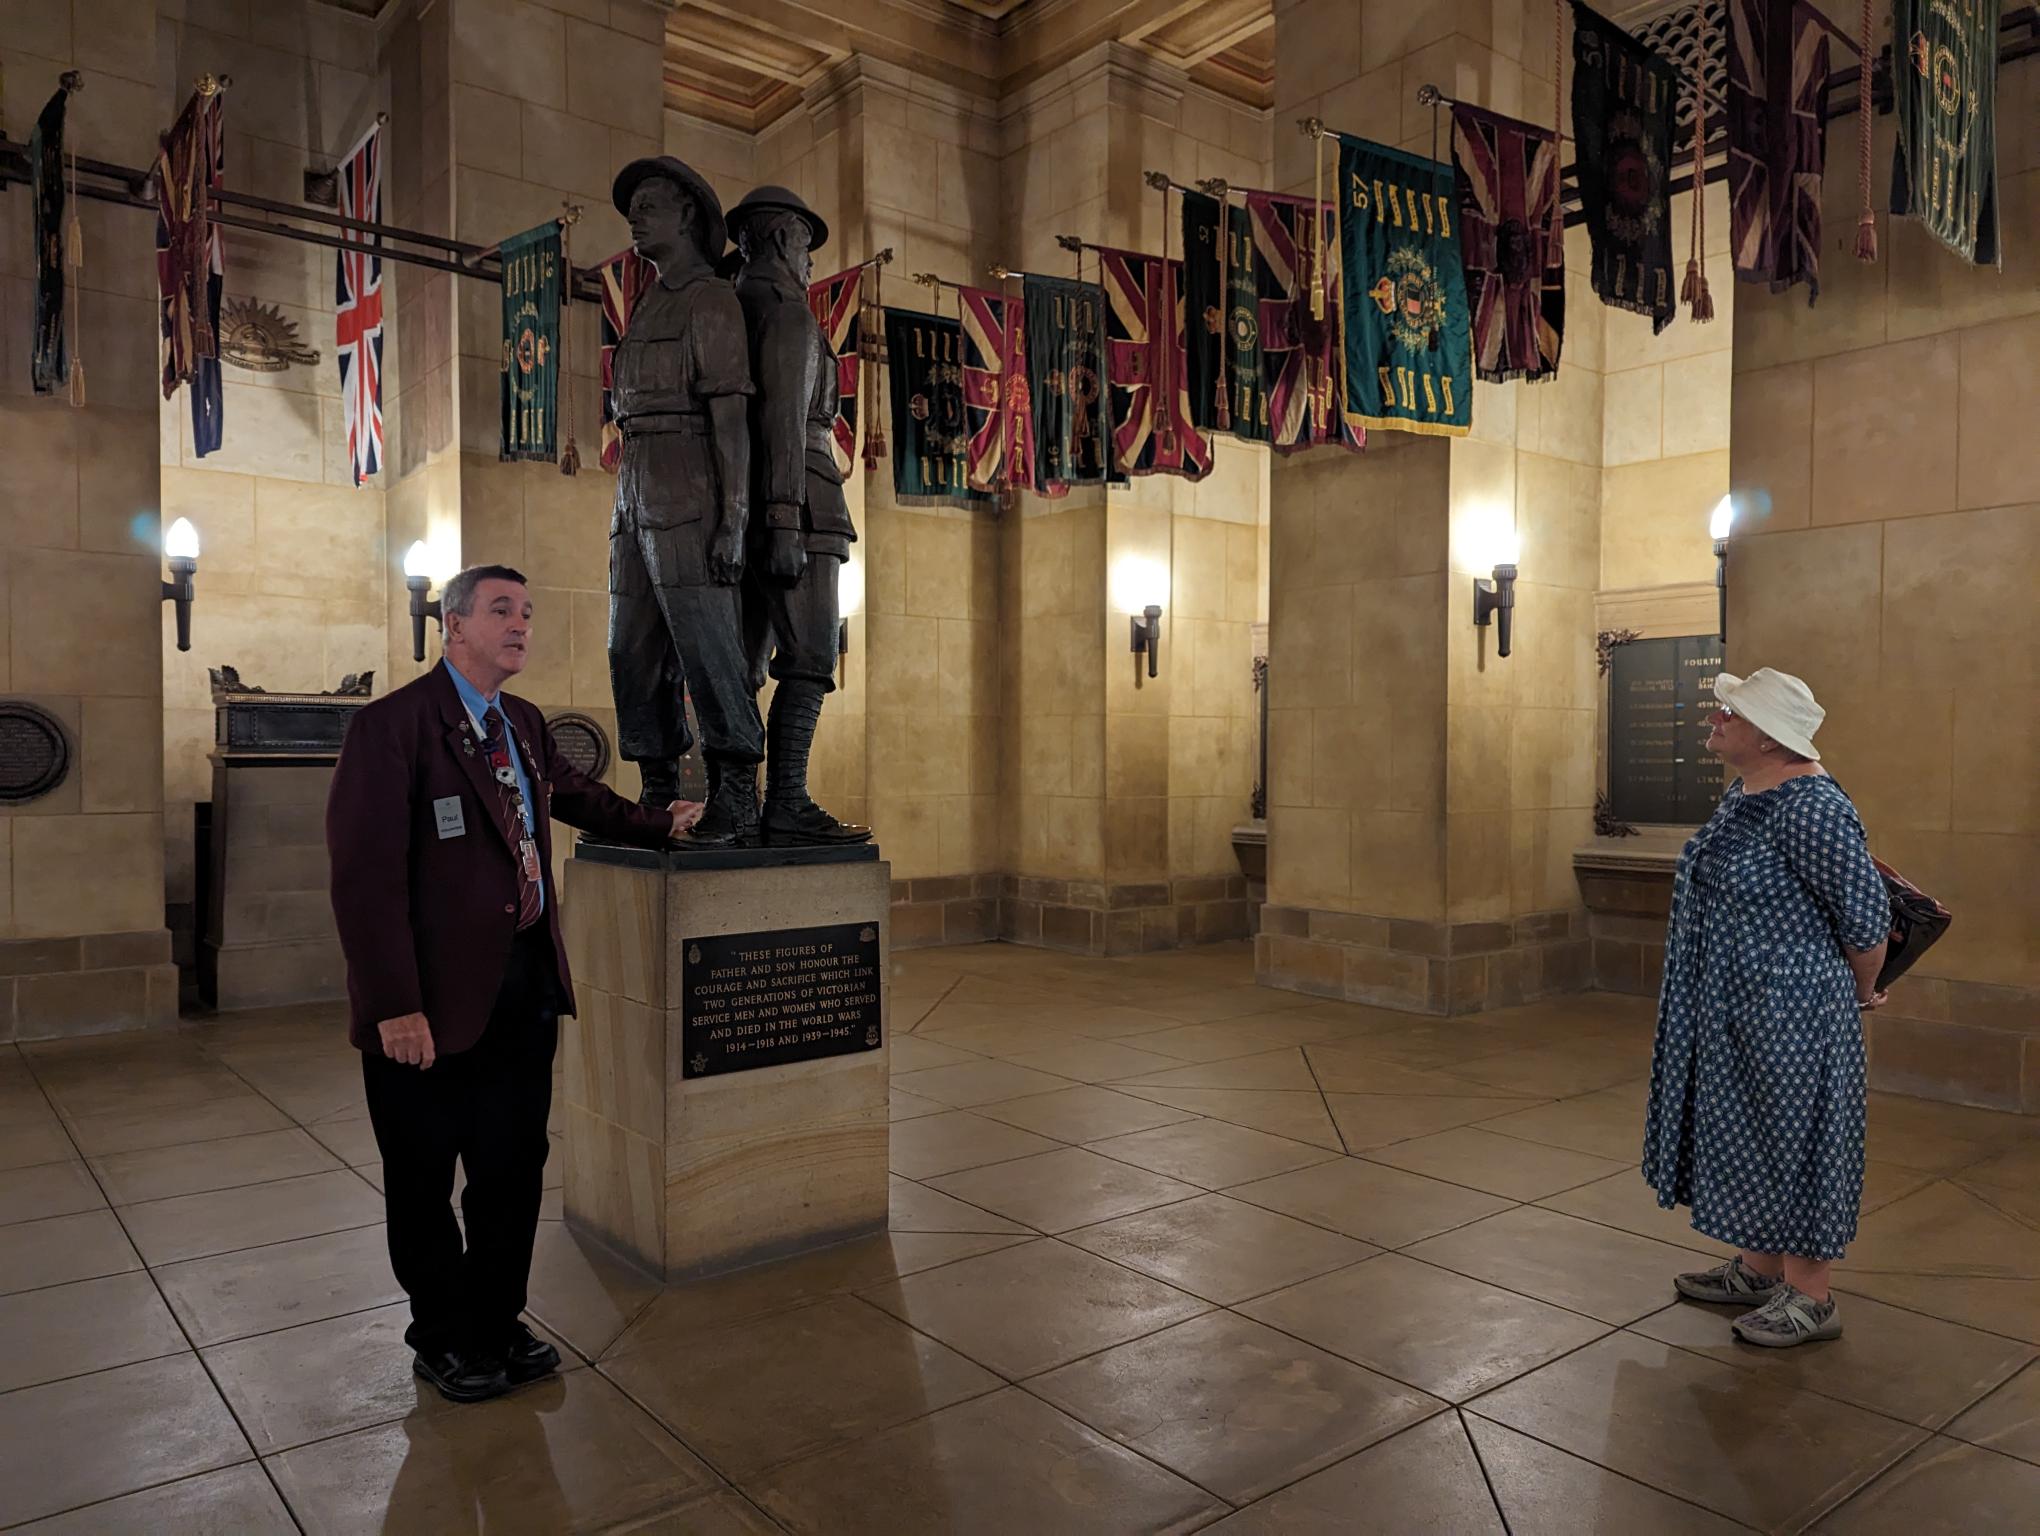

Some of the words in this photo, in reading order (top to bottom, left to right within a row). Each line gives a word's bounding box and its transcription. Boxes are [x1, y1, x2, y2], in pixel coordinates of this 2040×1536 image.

[1351, 172, 1369, 209] 57
[1684, 657, 1721, 667] FOURTH
[776, 946, 816, 958] FIGURES
[821, 944, 833, 953] OF
[694, 983, 742, 995] COURAGE
[747, 979, 766, 990] AND
[771, 973, 816, 987] SACRIFICE
[821, 970, 849, 980] WHICH
[854, 967, 873, 977] LINK
[712, 967, 746, 979] FATHER
[751, 965, 771, 975] AND
[776, 962, 795, 971] SON
[801, 958, 838, 969] HONOUR
[842, 955, 859, 963] THE
[704, 1000, 725, 1010] TWO
[732, 990, 796, 1006] GENERATIONS
[801, 988, 813, 998] OF
[817, 981, 865, 995] VICTORIAN
[692, 1013, 730, 1026] SERVICE
[734, 1011, 754, 1021] MEN
[759, 1007, 778, 1017] AND
[783, 1002, 816, 1014] WOMEN
[820, 999, 840, 1009] WHO
[845, 994, 876, 1006] SERVED
[710, 1028, 732, 1039] AND
[737, 1025, 760, 1036] DIED
[765, 1023, 775, 1032] IN
[779, 1020, 797, 1029] THE
[802, 1015, 833, 1025] WORLD
[838, 1010, 861, 1021] WARS
[779, 1034, 798, 1045] AND
